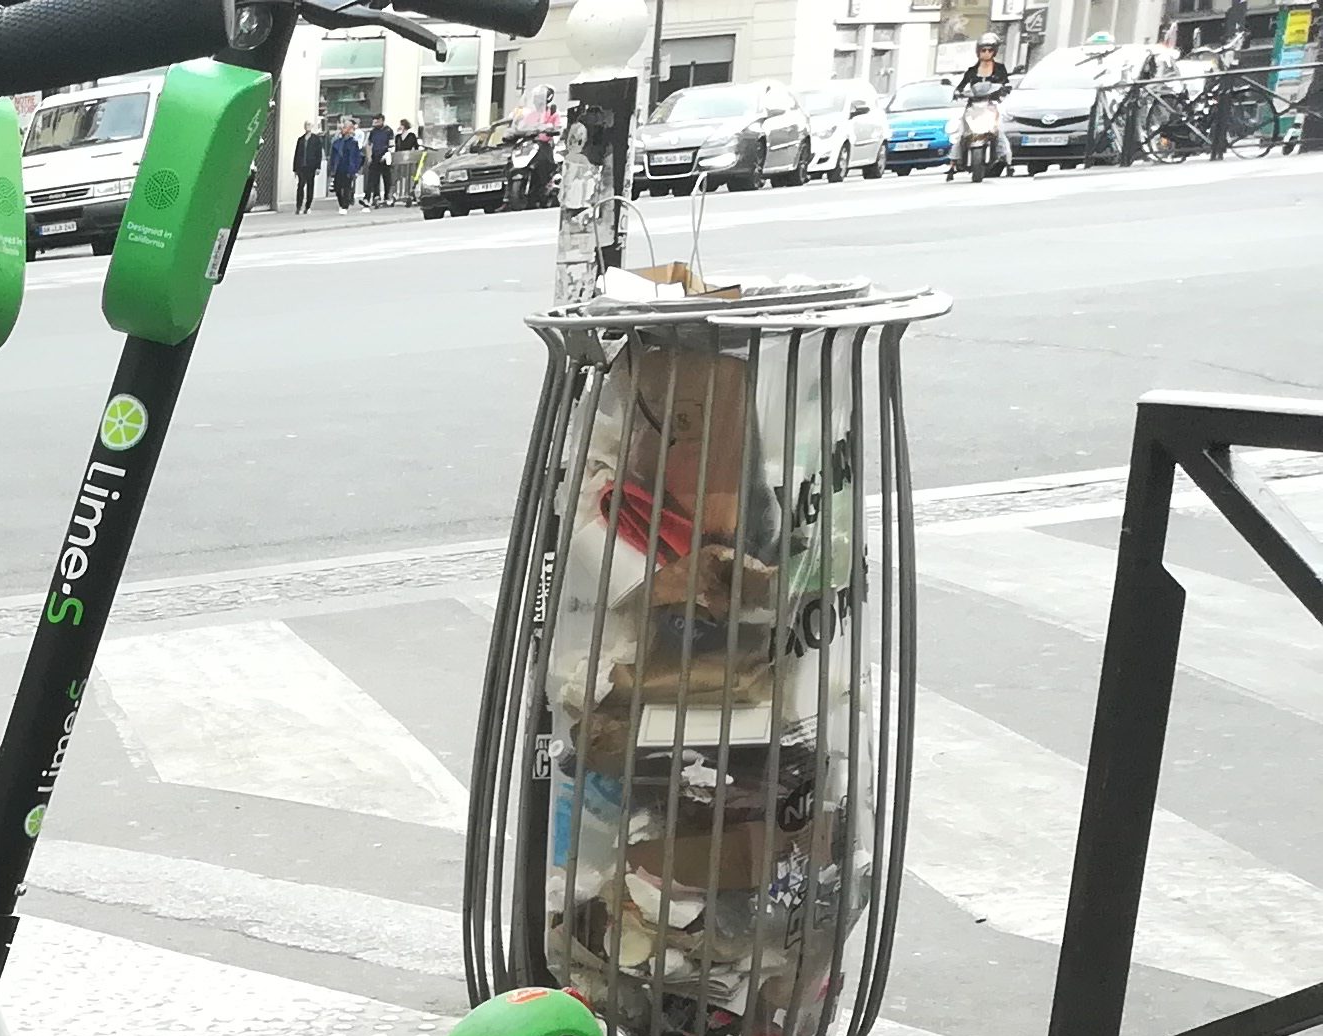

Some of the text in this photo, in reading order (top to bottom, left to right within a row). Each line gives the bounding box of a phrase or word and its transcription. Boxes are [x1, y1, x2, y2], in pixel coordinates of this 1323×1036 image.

[126, 221, 173, 239] Designed in
[128, 232, 166, 249] California
